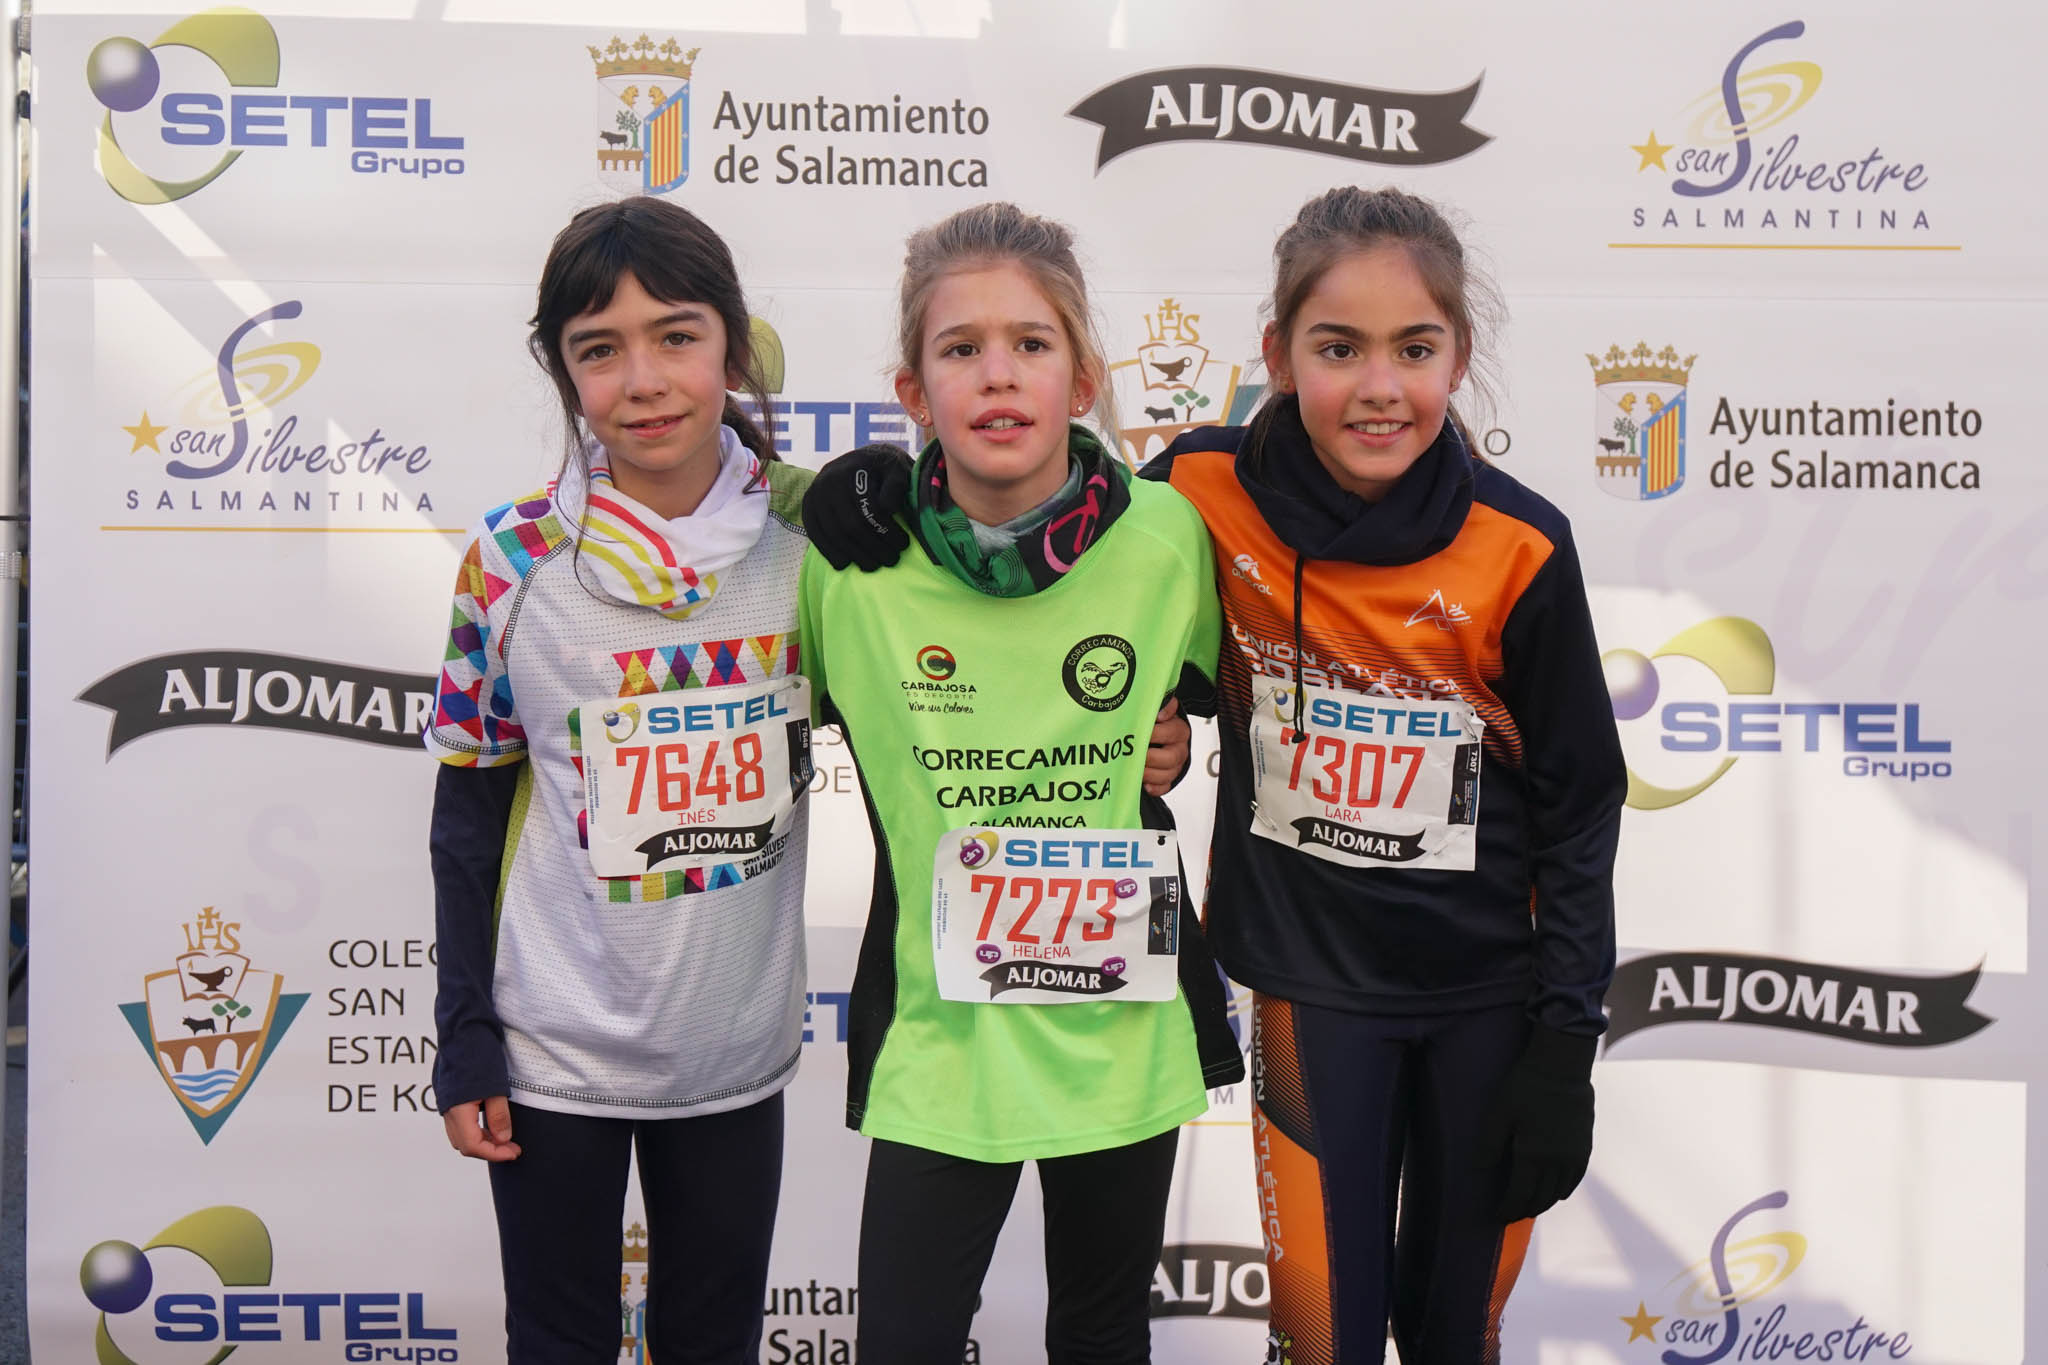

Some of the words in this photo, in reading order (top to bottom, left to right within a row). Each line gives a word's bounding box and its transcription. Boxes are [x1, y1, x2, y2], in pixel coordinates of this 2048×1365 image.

[160, 93, 464, 149] SETEL
[713, 91, 990, 139] Ayuntamiento
[1145, 83, 1420, 152] ALJOMAR
[351, 151, 465, 179] Grupo
[714, 145, 759, 184] de
[776, 144, 989, 188] Salamanca
[1675, 148, 1729, 175] san
[1633, 208, 1930, 230] SALMANTINA
[742, 401, 932, 452] ETE
[1709, 396, 1983, 444] Ayuntamiento
[169, 426, 227, 456] san
[1711, 449, 1754, 488] de
[1770, 449, 1981, 490] Salamanca
[126, 489, 433, 512] SALMANTINA
[1067, 637, 1134, 665] CORRECAMINOS
[159, 666, 434, 735] ALJOMAR
[901, 681, 977, 693] CARBAJOSA
[1081, 694, 1125, 711] Carbajosa
[647, 693, 789, 734] SETEL
[1310, 698, 1462, 737] SETEL
[1660, 702, 1951, 752] SETEL
[912, 734, 1136, 772] CORRECAMINOS
[1280, 727, 1426, 809] 7307
[1469, 750, 1478, 773] 7307
[615, 732, 766, 815] 7648
[1842, 756, 1952, 782] Grupo
[936, 777, 1111, 809] CARBAJOSA
[676, 808, 717, 826] INÉS
[1325, 804, 1362, 823] LARA
[663, 832, 757, 854] ALJOMAR
[1004, 839, 1154, 868] SETEL
[1311, 823, 1401, 857] ALJOMAR
[1168, 881, 1177, 903] 7273
[970, 874, 1118, 945] 7273
[1013, 943, 1072, 960] HELENA
[1006, 967, 1102, 989] ALJOMAR
[328, 988, 405, 1016] SAN
[1649, 965, 1923, 1035] ALJOMAR
[328, 1084, 377, 1112] DE
[1258, 1112, 1284, 1264] ATLÉTICA
[1150, 1259, 1271, 1315] ALJO
[154, 1292, 458, 1342] SETEL
[1665, 1318, 1718, 1345] san
[345, 1342, 459, 1365] Grupo
